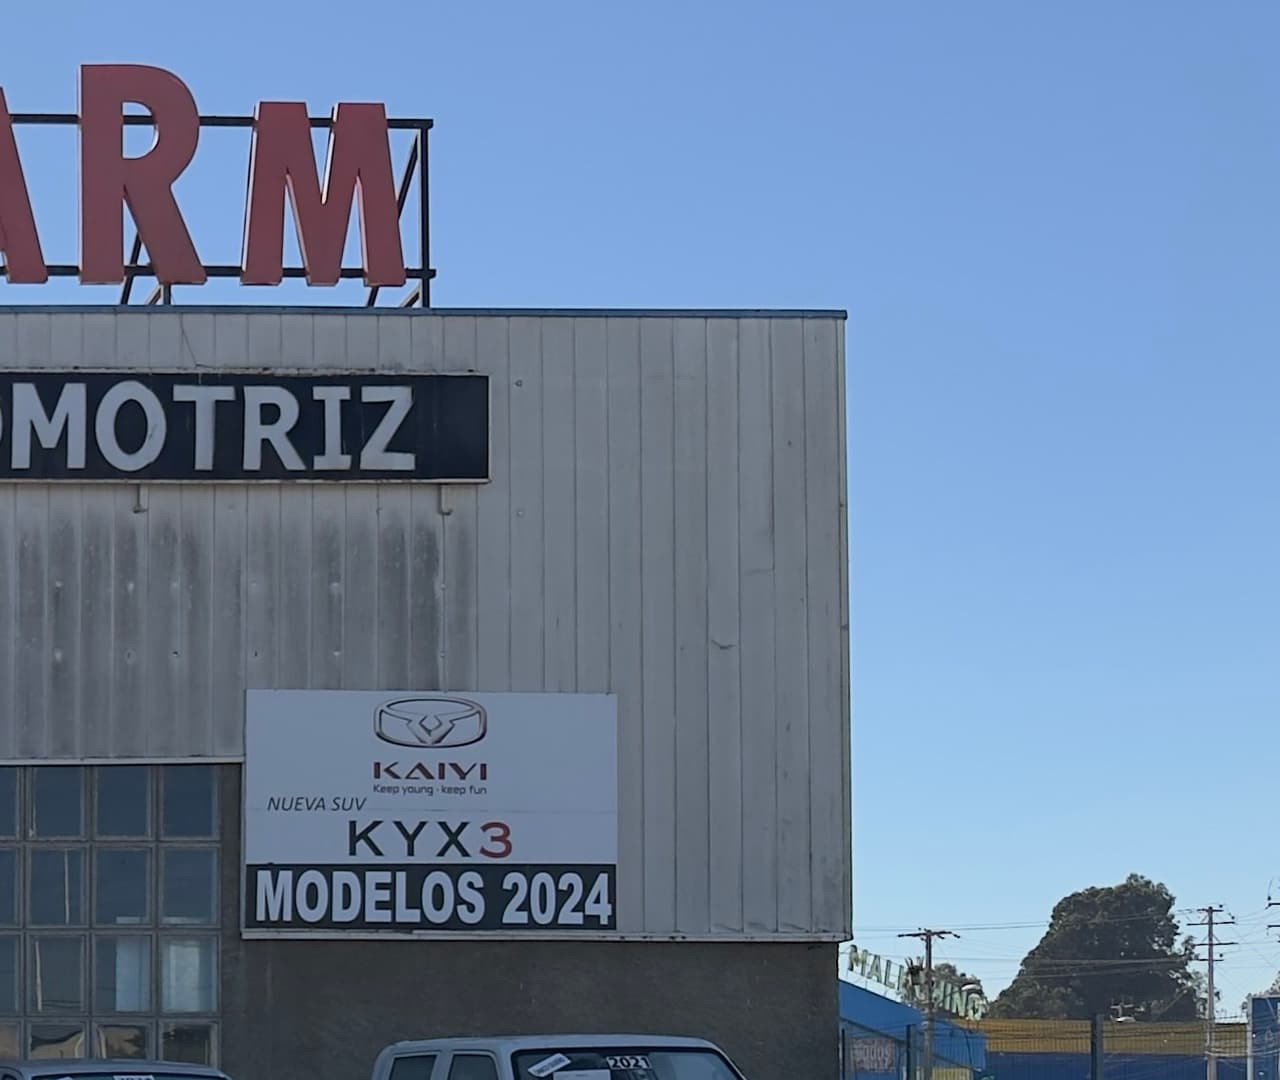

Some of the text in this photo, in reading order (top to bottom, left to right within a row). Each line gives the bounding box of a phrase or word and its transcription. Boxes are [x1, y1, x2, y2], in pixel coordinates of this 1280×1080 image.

[372, 761, 488, 781] KAIYI
[373, 784, 488, 797] Keep young keep fun
[267, 796, 368, 812] NUEVA SUV
[348, 820, 513, 858] KYX3
[255, 869, 612, 926] MODELOS 2024
[609, 1057, 650, 1070] 2021
